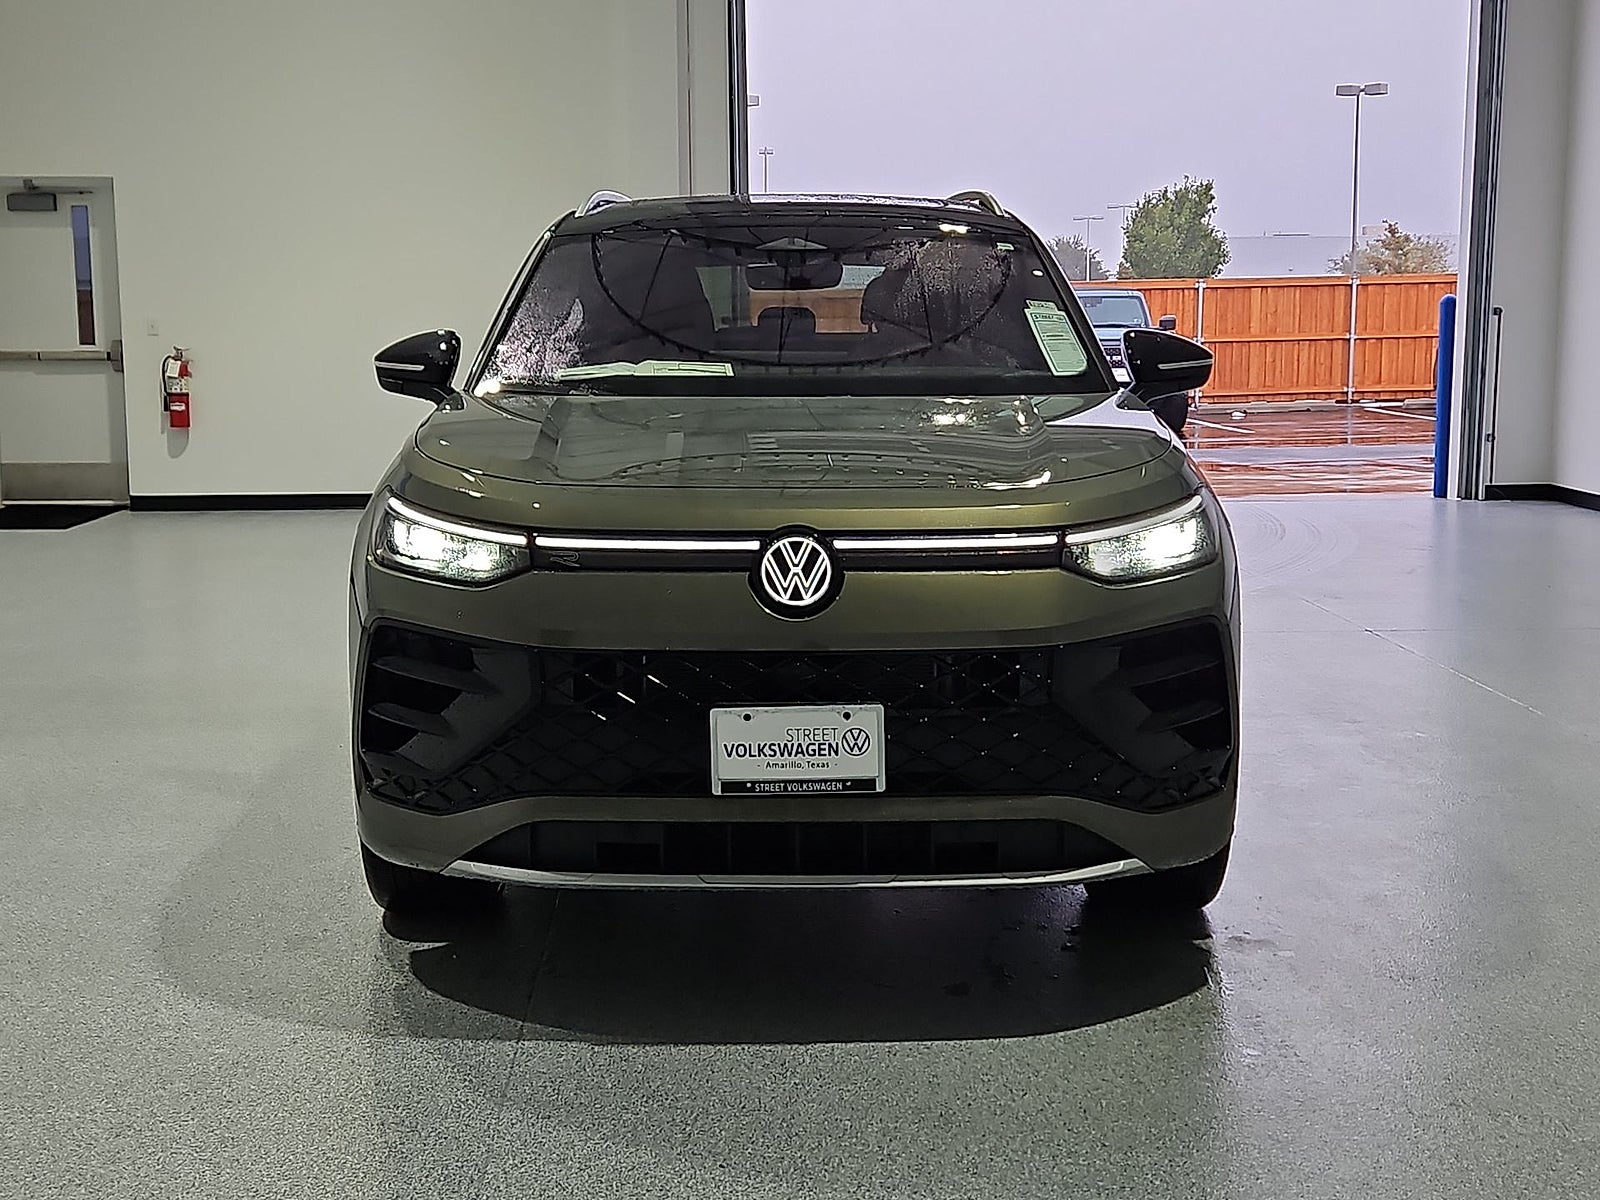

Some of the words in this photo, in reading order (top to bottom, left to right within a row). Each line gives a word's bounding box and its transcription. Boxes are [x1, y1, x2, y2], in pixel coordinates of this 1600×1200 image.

[762, 538, 830, 604] VW
[785, 727, 839, 742] STREET
[842, 728, 871, 756] VW
[723, 742, 839, 758] VOLKSWAGEN
[765, 761, 805, 770] Amarillo,
[807, 760, 830, 769] Texas
[755, 783, 785, 792] STREET
[787, 781, 843, 791] VOLKSWAGEN
